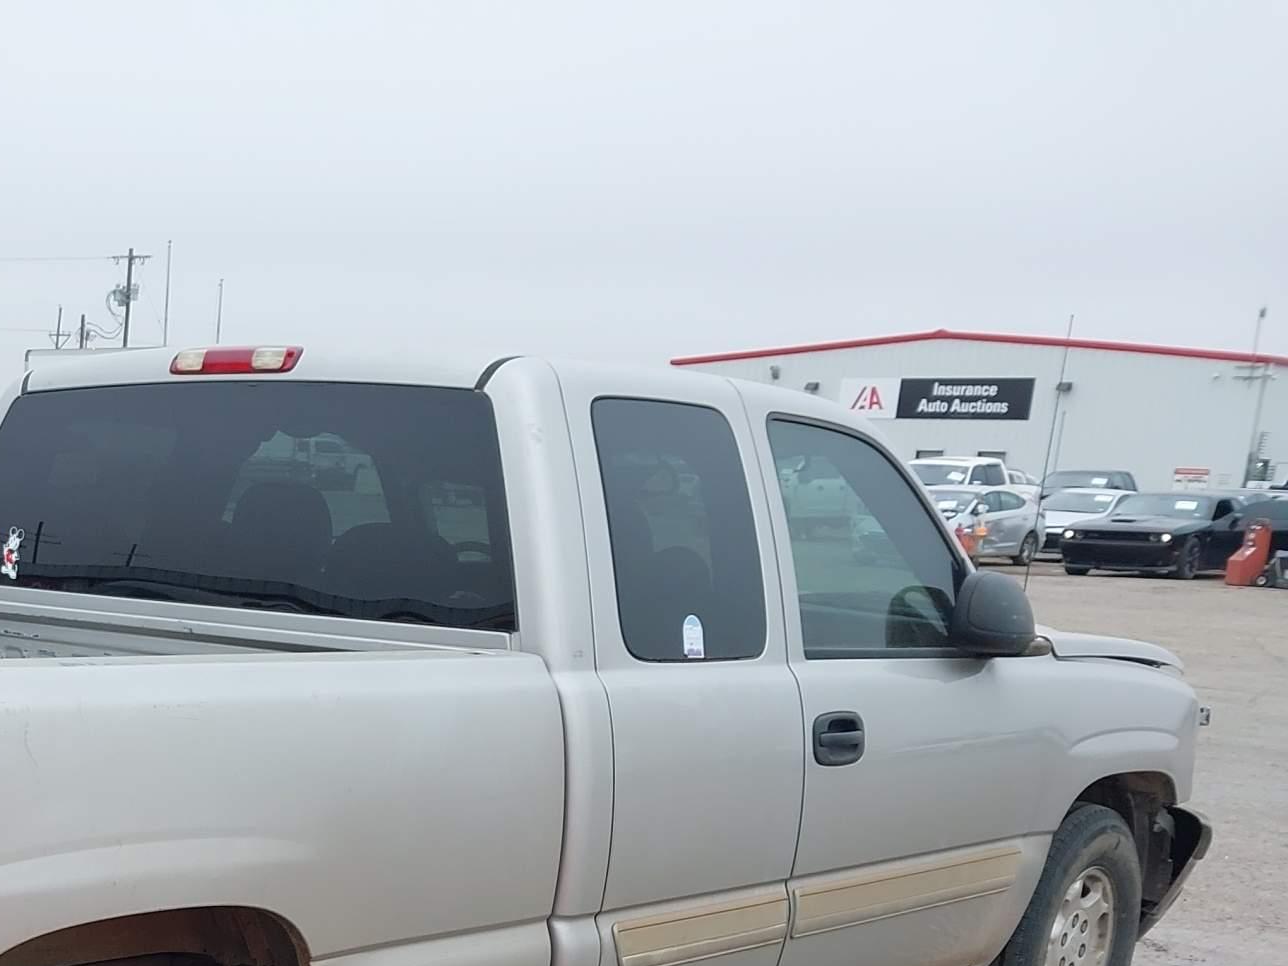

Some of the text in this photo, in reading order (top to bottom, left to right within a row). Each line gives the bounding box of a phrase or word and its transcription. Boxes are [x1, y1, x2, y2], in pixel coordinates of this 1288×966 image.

[932, 382, 998, 397] Insurance
[916, 398, 1009, 413] Auto Auctions
